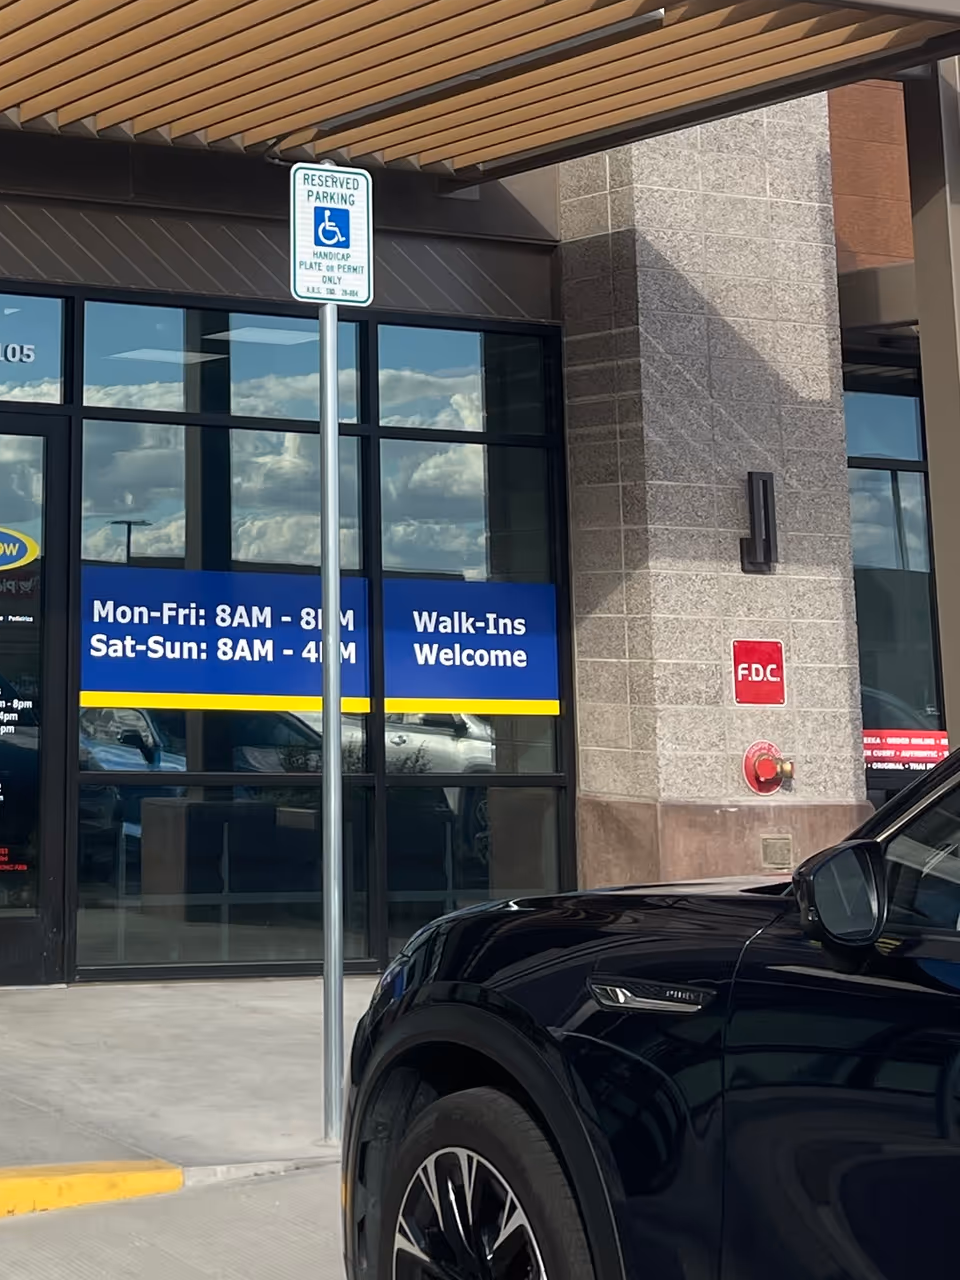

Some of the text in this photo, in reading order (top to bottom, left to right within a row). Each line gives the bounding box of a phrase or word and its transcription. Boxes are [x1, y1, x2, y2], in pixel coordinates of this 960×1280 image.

[303, 173, 360, 191] RESERVED
[307, 190, 355, 206] PARKING
[313, 250, 351, 262] HANDICAP
[299, 261, 323, 271] PLATE
[338, 264, 364, 275] PERMIT
[322, 275, 343, 285] ONLY
[92, 600, 206, 627] Mon-Fri:
[215, 605, 272, 629] 8AM
[413, 610, 526, 636] Walk-Ins
[90, 634, 207, 660] Sat-Sun:
[216, 639, 274, 662] 8AM
[301, 640, 356, 664] 4M
[414, 643, 527, 668] Welcome
[737, 663, 781, 682] F.D.C.
[12, 699, 33, 710] 8pm
